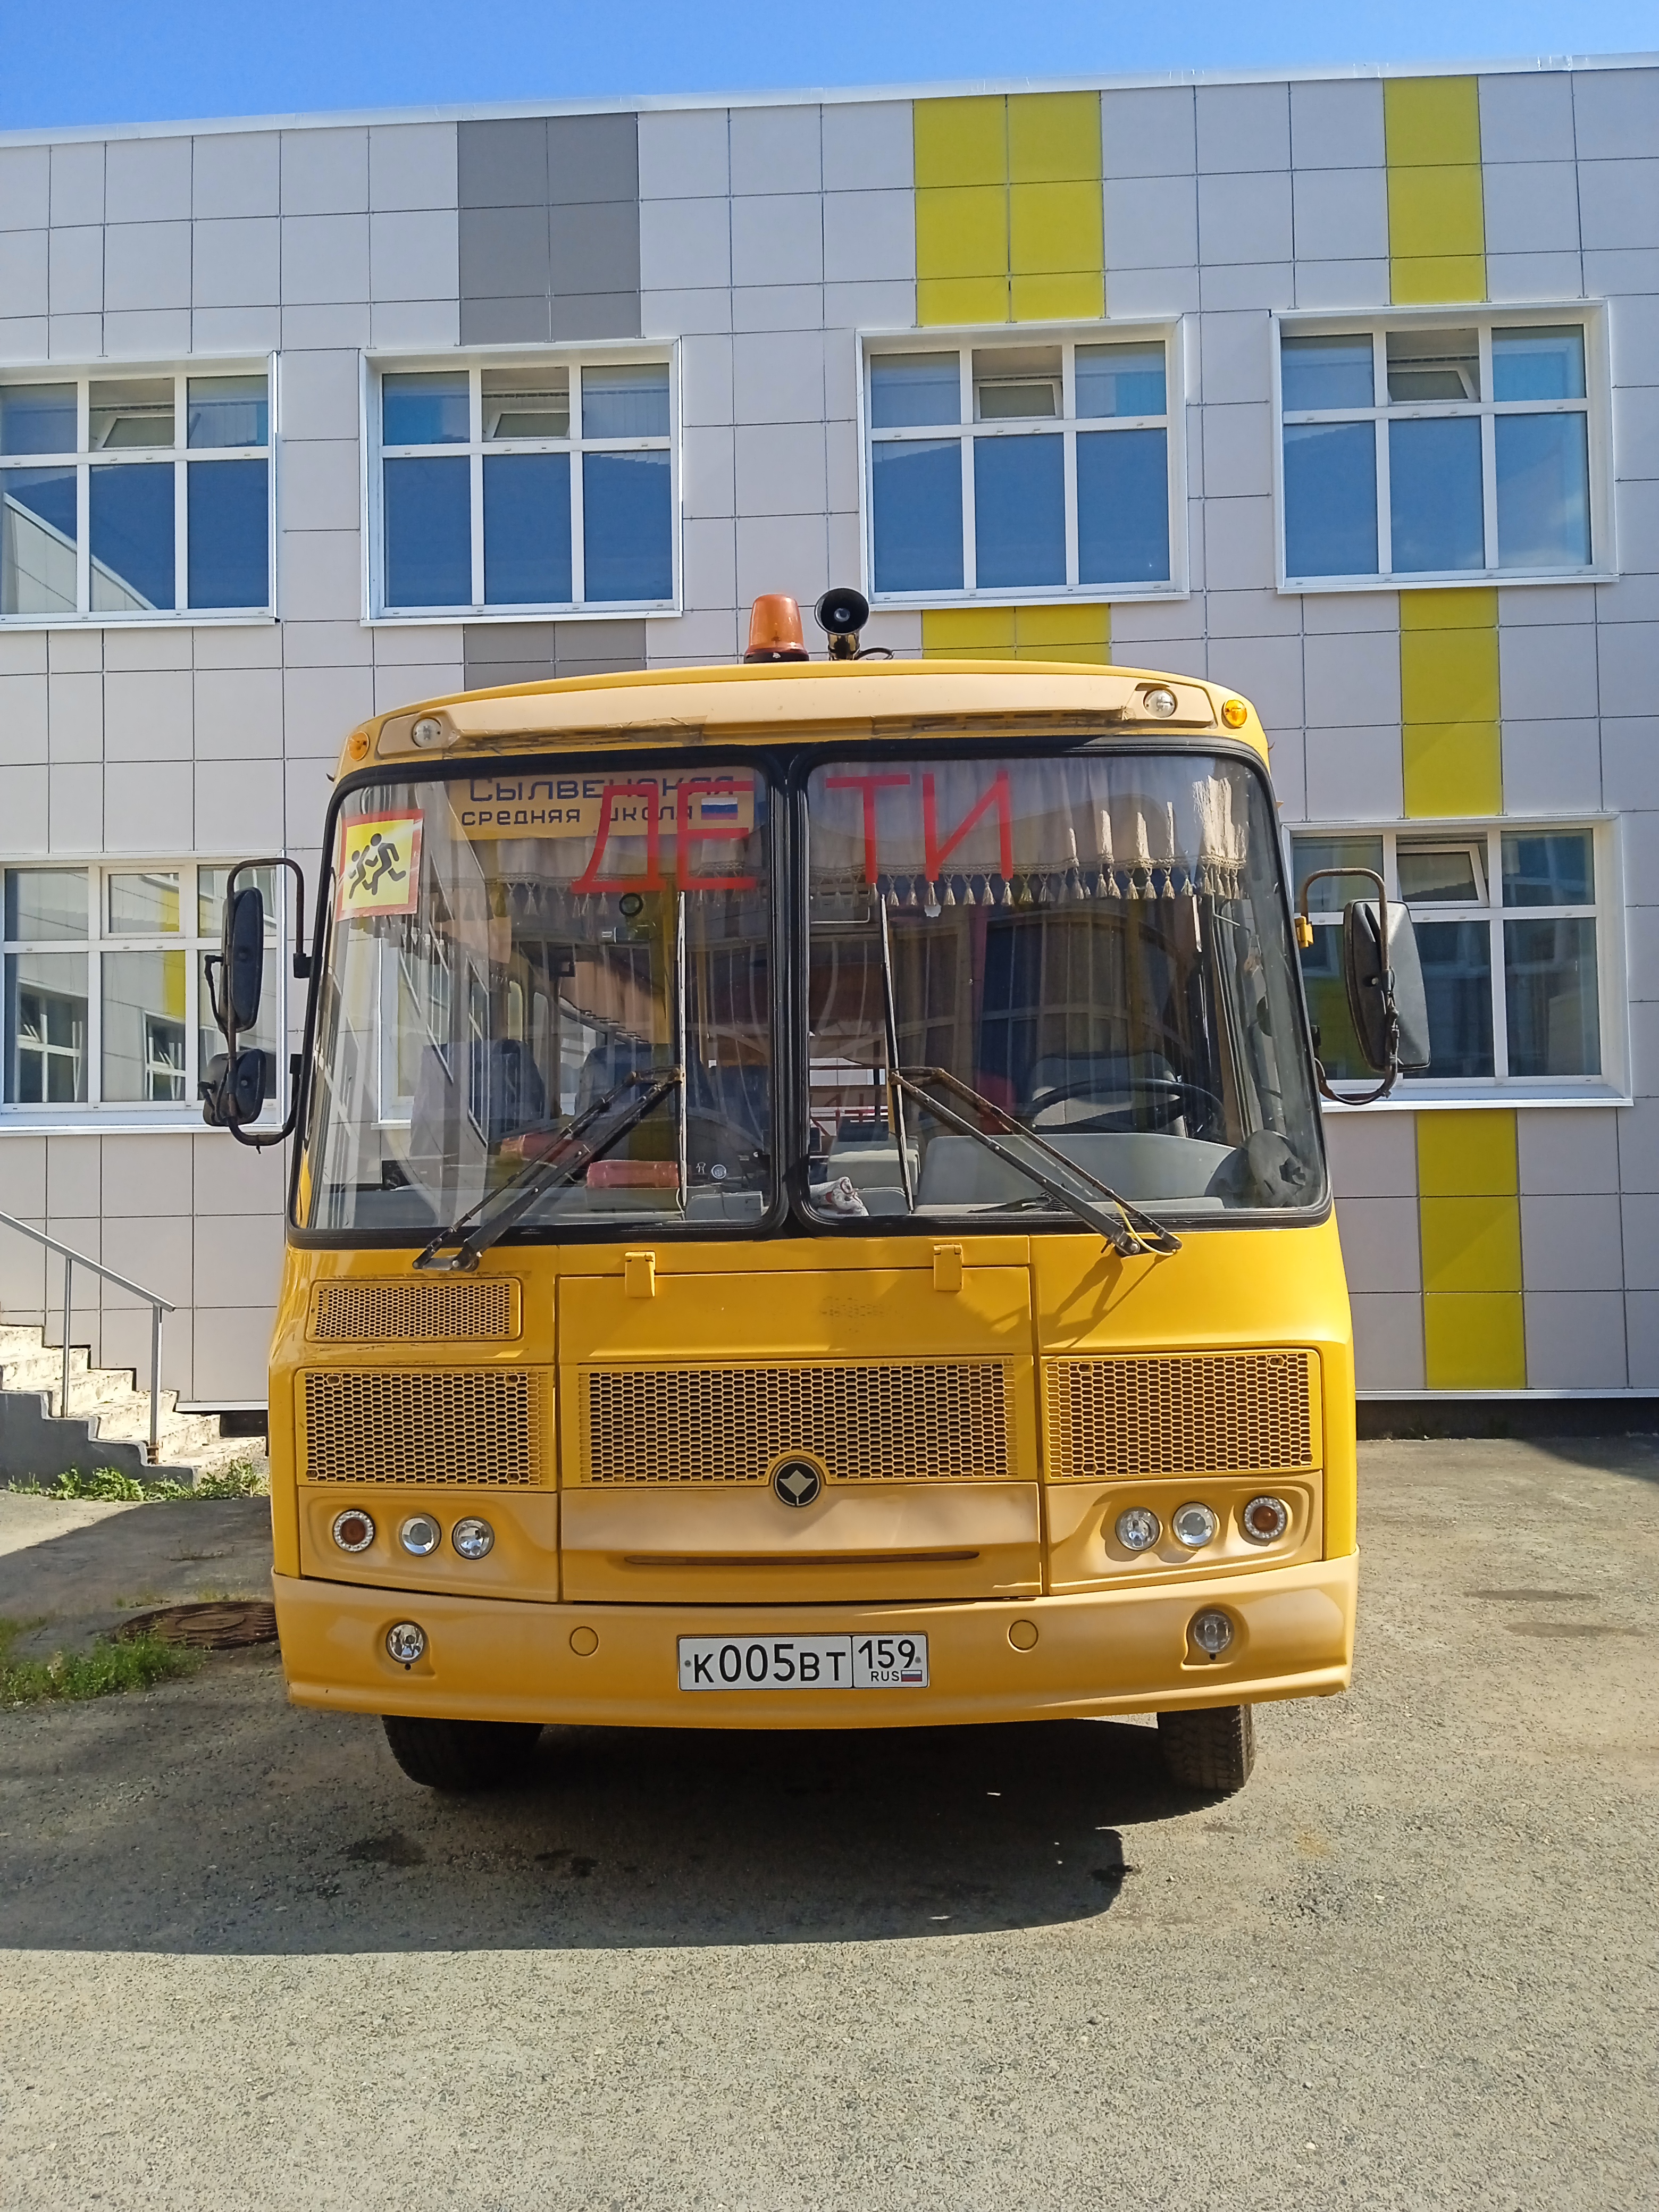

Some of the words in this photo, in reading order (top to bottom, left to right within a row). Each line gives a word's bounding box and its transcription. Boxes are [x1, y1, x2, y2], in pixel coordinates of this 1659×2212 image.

[462, 809, 581, 826] средняя
[694, 1644, 847, 1683] К005ВТ
[858, 1639, 916, 1669] 159
[870, 1671, 900, 1682] RUS
